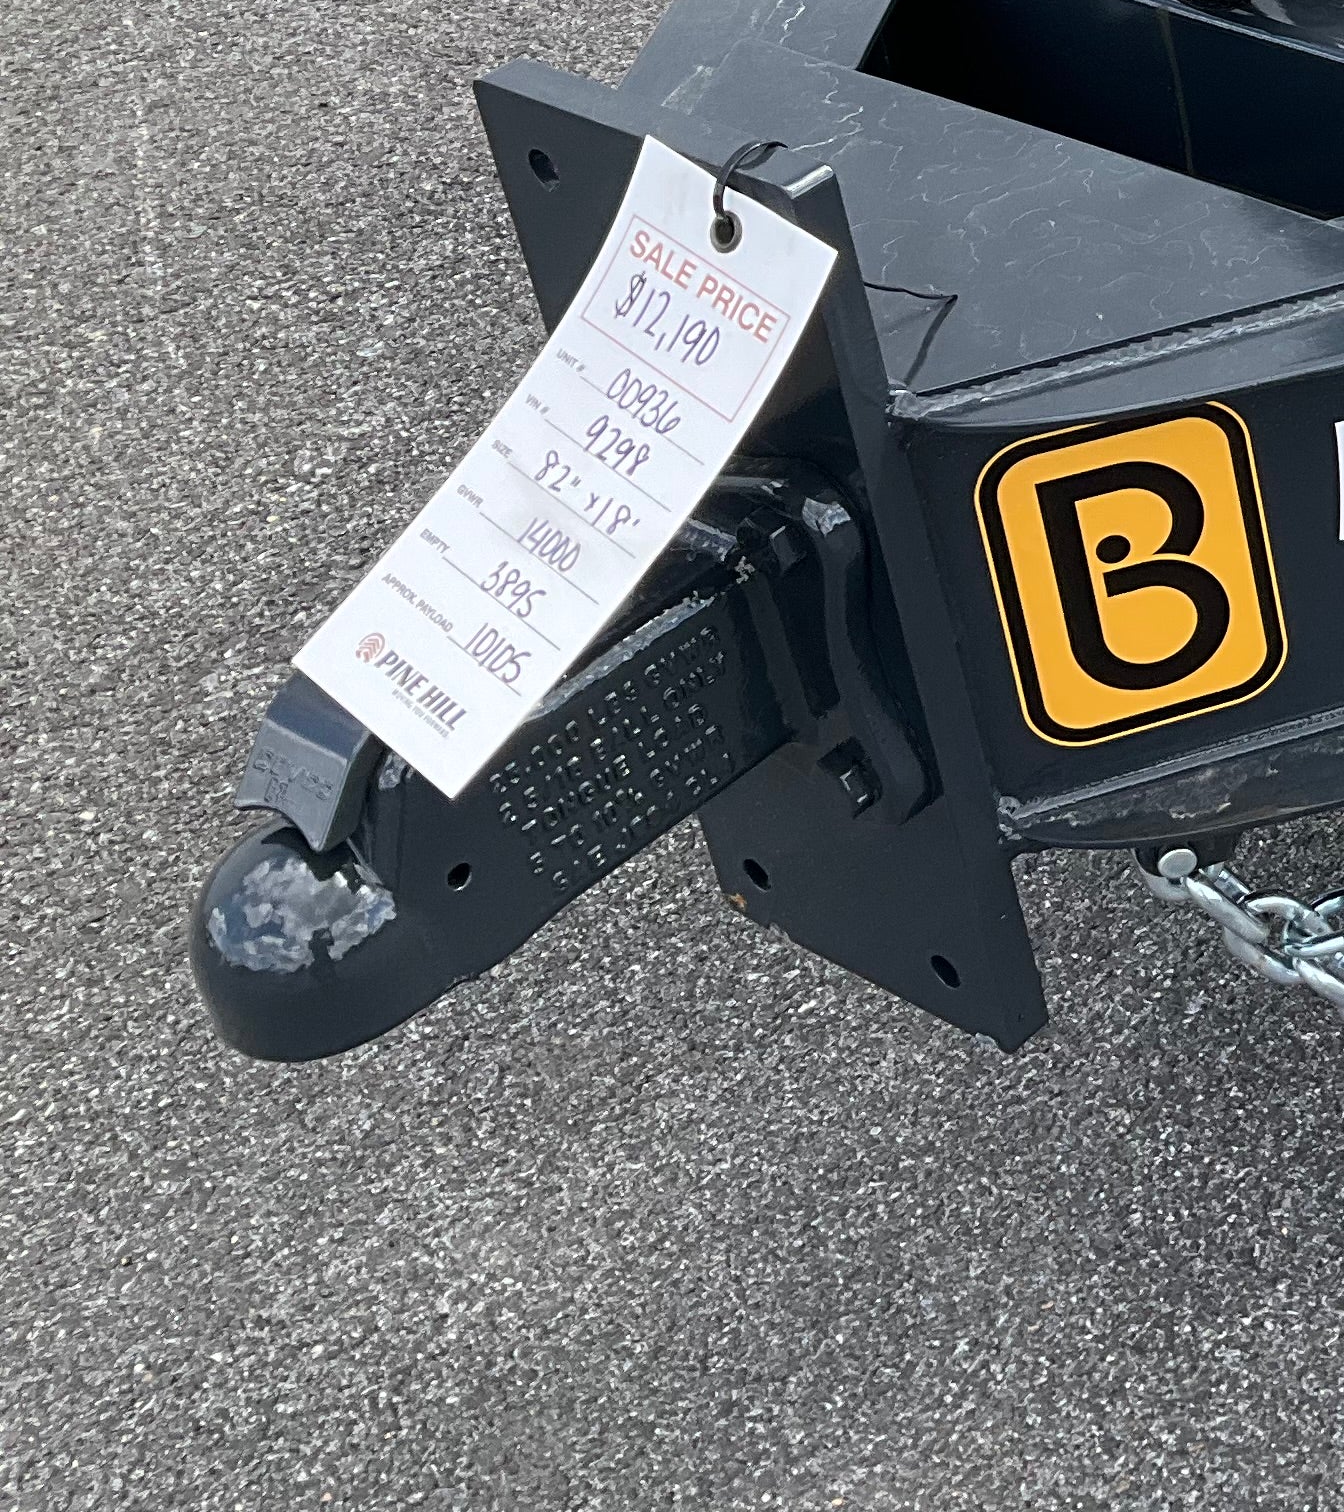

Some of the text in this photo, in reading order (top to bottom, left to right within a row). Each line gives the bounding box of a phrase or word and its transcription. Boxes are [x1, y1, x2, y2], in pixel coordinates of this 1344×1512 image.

[614, 271, 721, 366] $12,190
[630, 229, 779, 344] SALE PRICE
[525, 393, 542, 410] VIN
[583, 414, 650, 476] 9298
[556, 348, 577, 369] UNIT
[606, 368, 681, 435] 00936
[491, 439, 513, 459] SIZE
[456, 484, 582, 572] GVWR 14000
[419, 528, 547, 619] EMPTY 3895
[381, 573, 532, 684] APPROX. PAYLOAD 10105
[373, 650, 467, 732] PINE HILL
